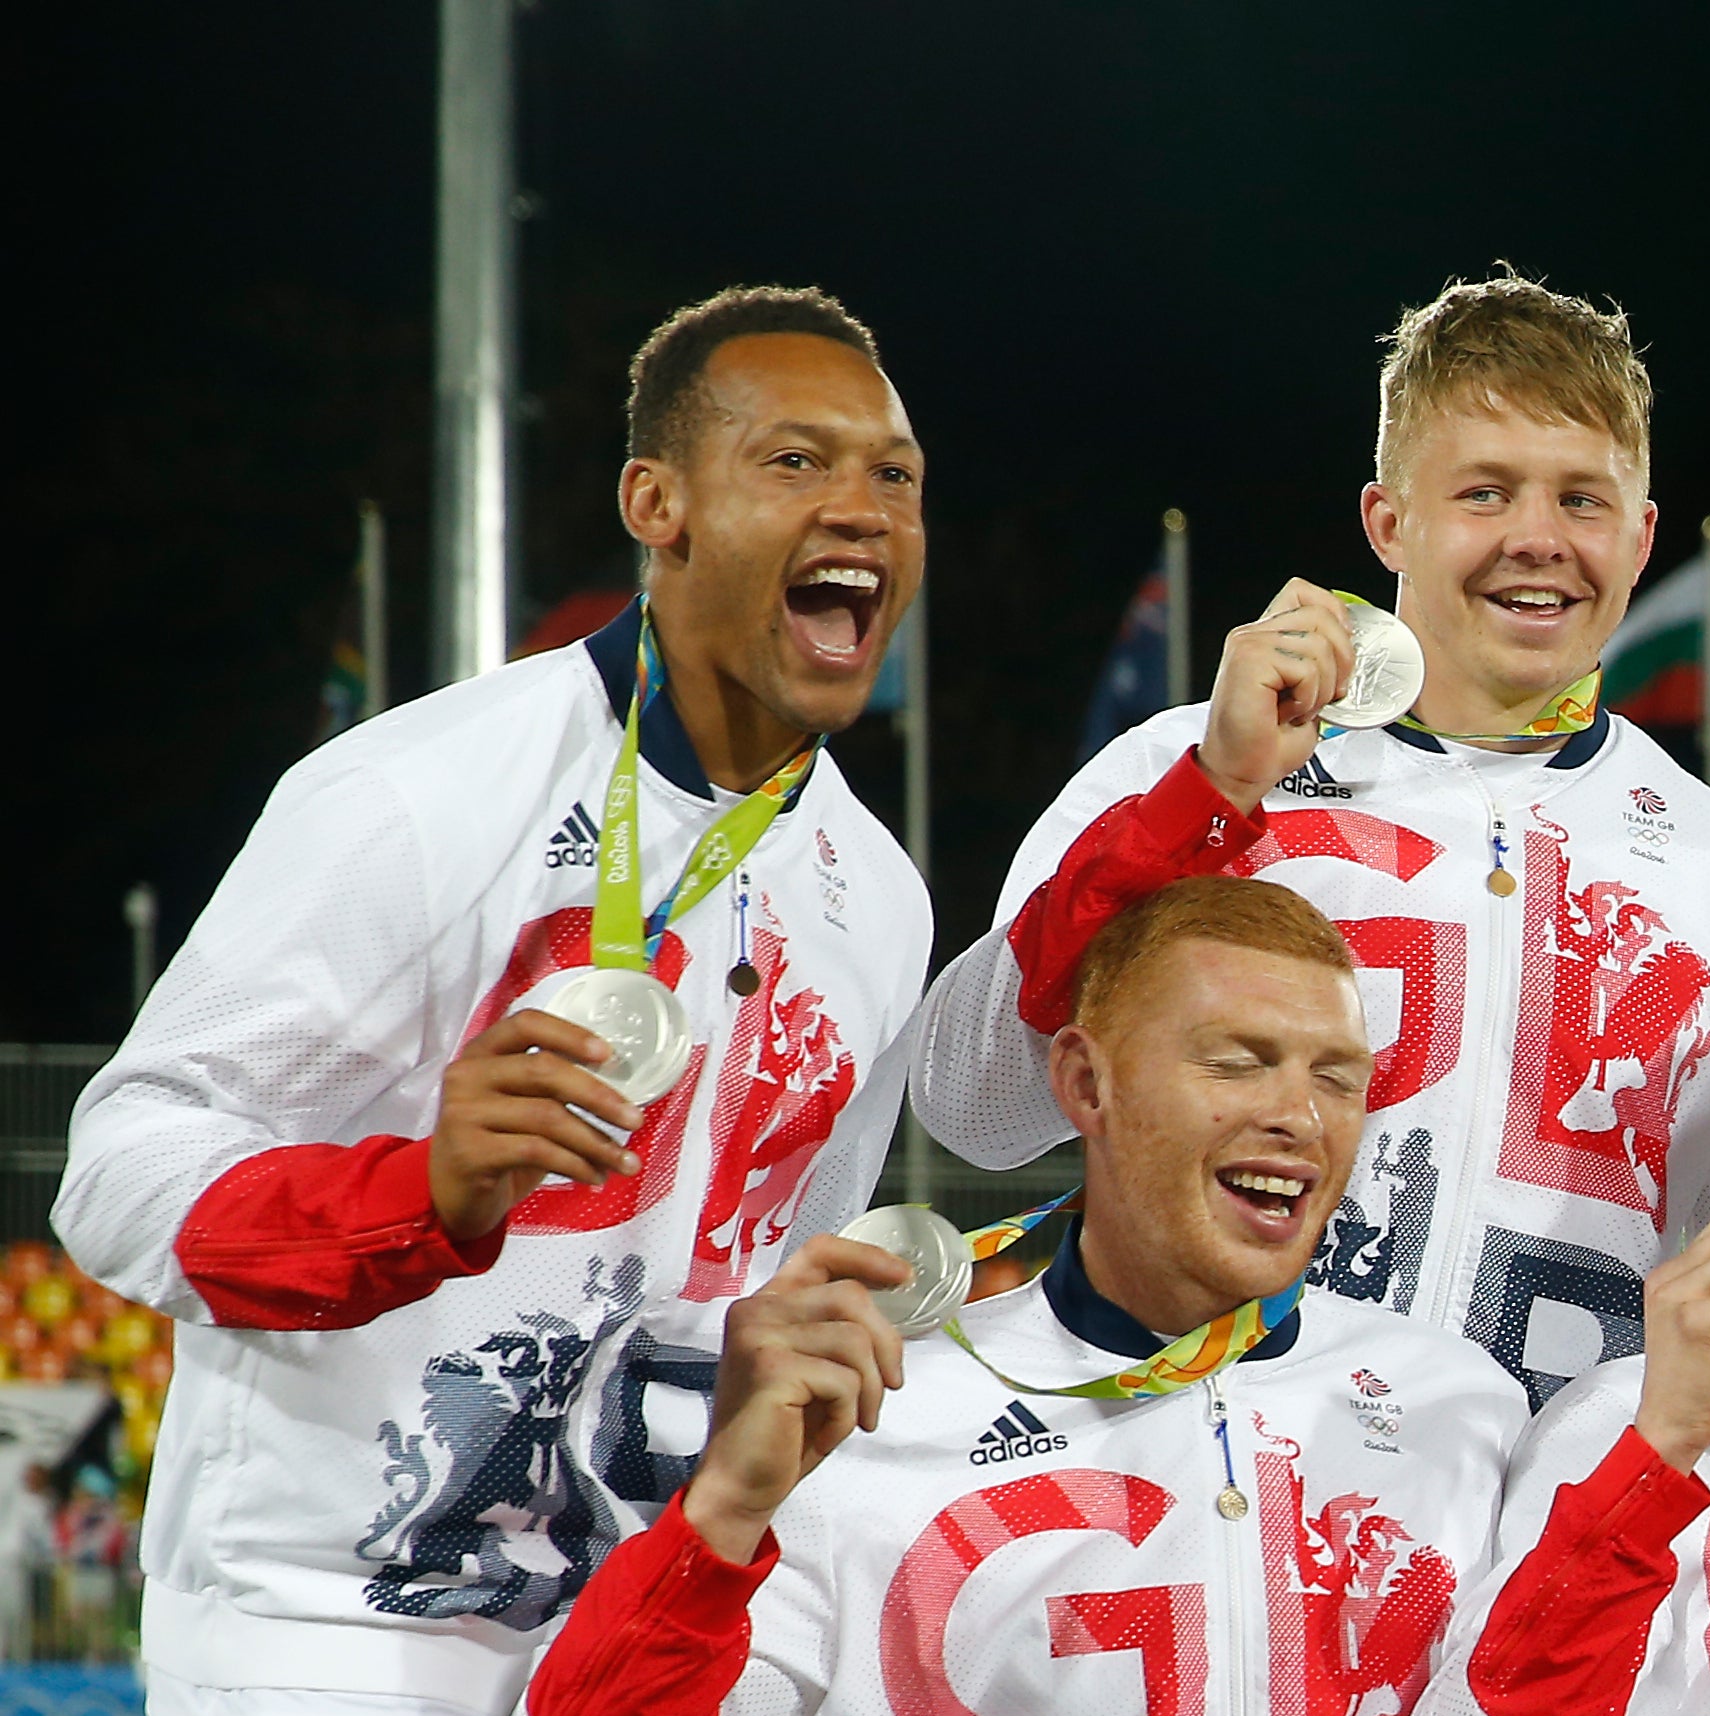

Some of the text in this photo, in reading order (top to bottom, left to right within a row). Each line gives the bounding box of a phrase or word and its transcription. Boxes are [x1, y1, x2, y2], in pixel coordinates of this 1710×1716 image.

[1275, 769, 1353, 800] didas
[1622, 811, 1676, 832] TEAM GB
[545, 841, 600, 870] adid
[1629, 845, 1668, 864] Rio2016
[1349, 1398, 1404, 1416] TEAM GB
[969, 1432, 1069, 1466] adidas
